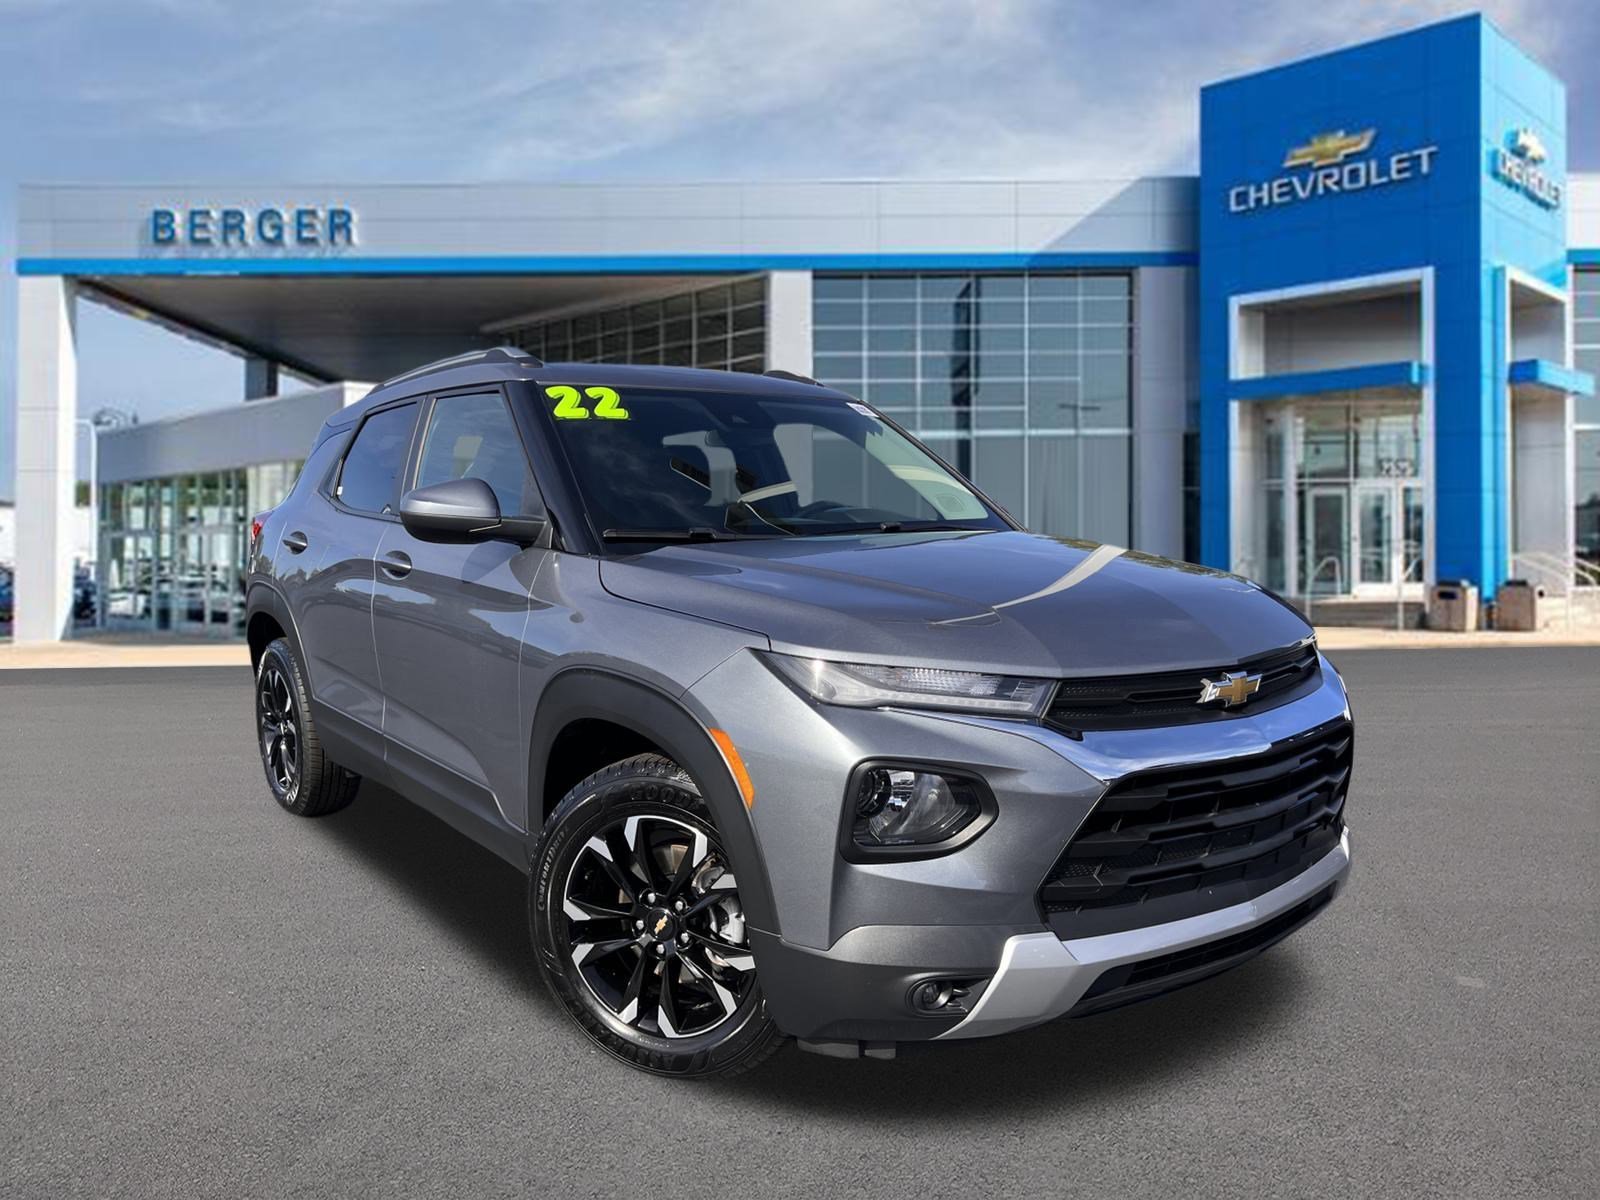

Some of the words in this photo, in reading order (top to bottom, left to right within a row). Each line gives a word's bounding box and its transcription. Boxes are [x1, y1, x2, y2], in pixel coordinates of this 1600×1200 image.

[1229, 146, 1439, 213] CHEVROLET
[152, 208, 355, 246] BERGER
[545, 385, 629, 420] 22
